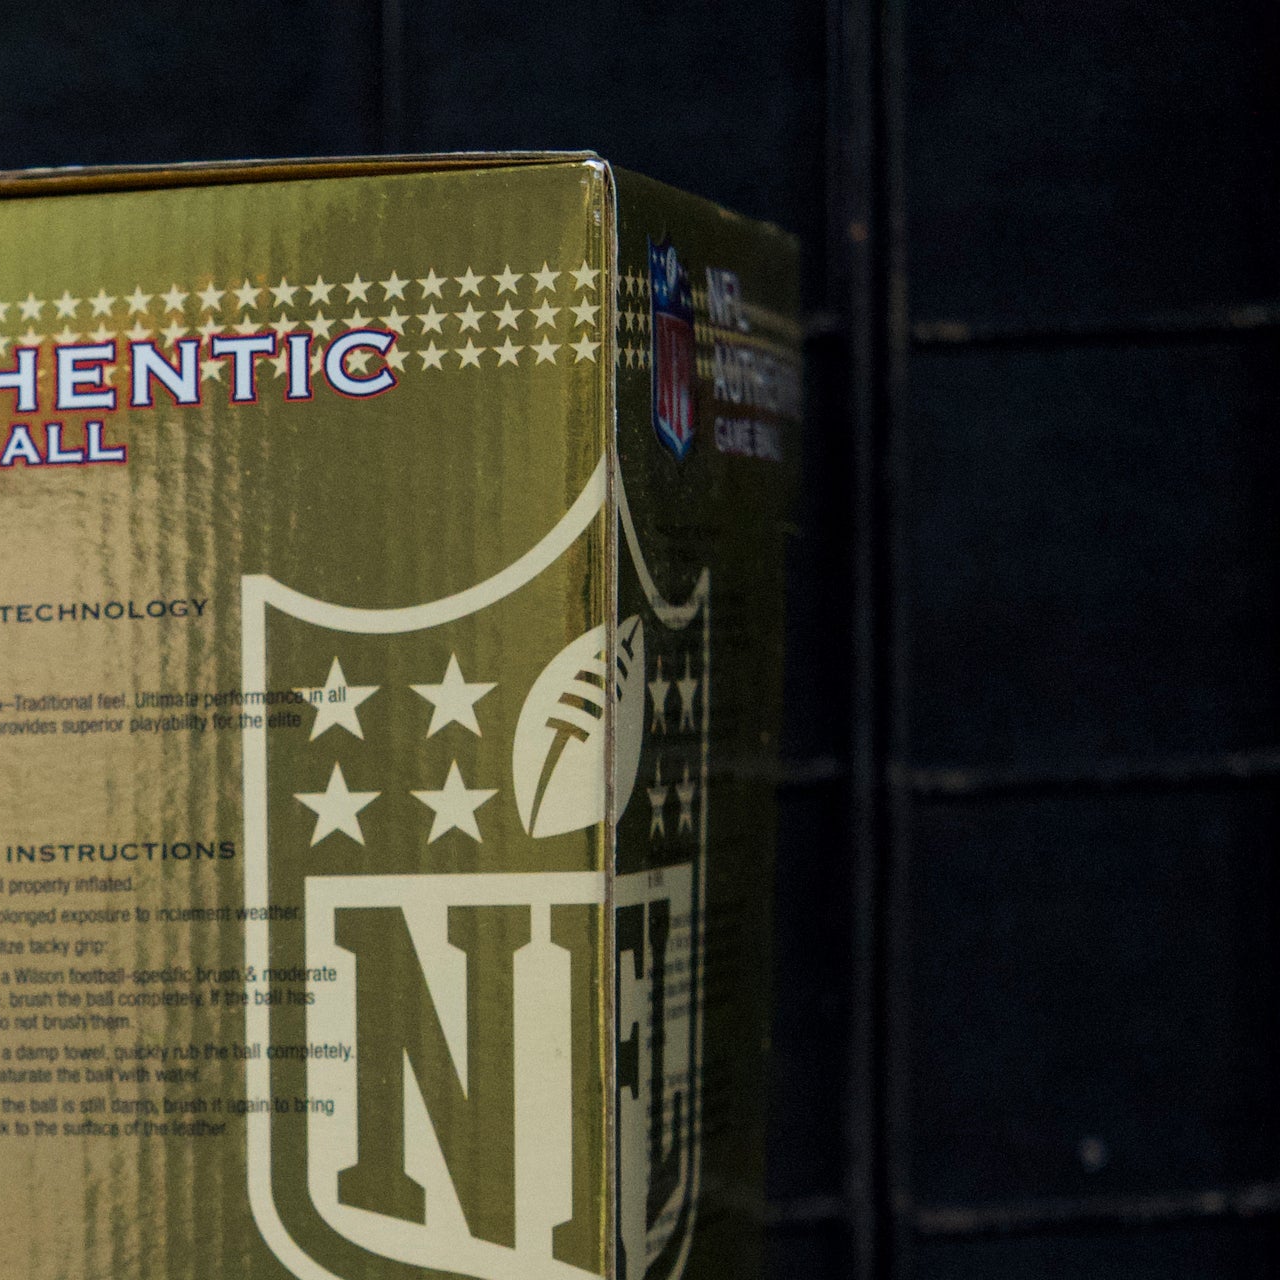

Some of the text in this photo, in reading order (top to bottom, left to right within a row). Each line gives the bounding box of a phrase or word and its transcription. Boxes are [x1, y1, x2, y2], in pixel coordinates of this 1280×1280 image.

[204, 688, 305, 709] performance
[308, 688, 323, 704] in
[327, 687, 347, 703] all
[62, 719, 124, 736] superior
[130, 715, 207, 733] playability
[212, 714, 233, 730] for
[239, 713, 263, 729] the
[267, 713, 302, 728] elite
[5, 843, 236, 863] INSTRUCTIONS
[61, 908, 131, 926] exposure
[246, 966, 258, 982] &
[262, 966, 338, 982] moderate
[254, 989, 283, 1005] ball
[286, 989, 316, 1005] has
[233, 1043, 262, 1059] ball
[266, 1043, 355, 1062] completely.
[275, 1098, 289, 1113] to
[293, 1097, 336, 1116] bring
